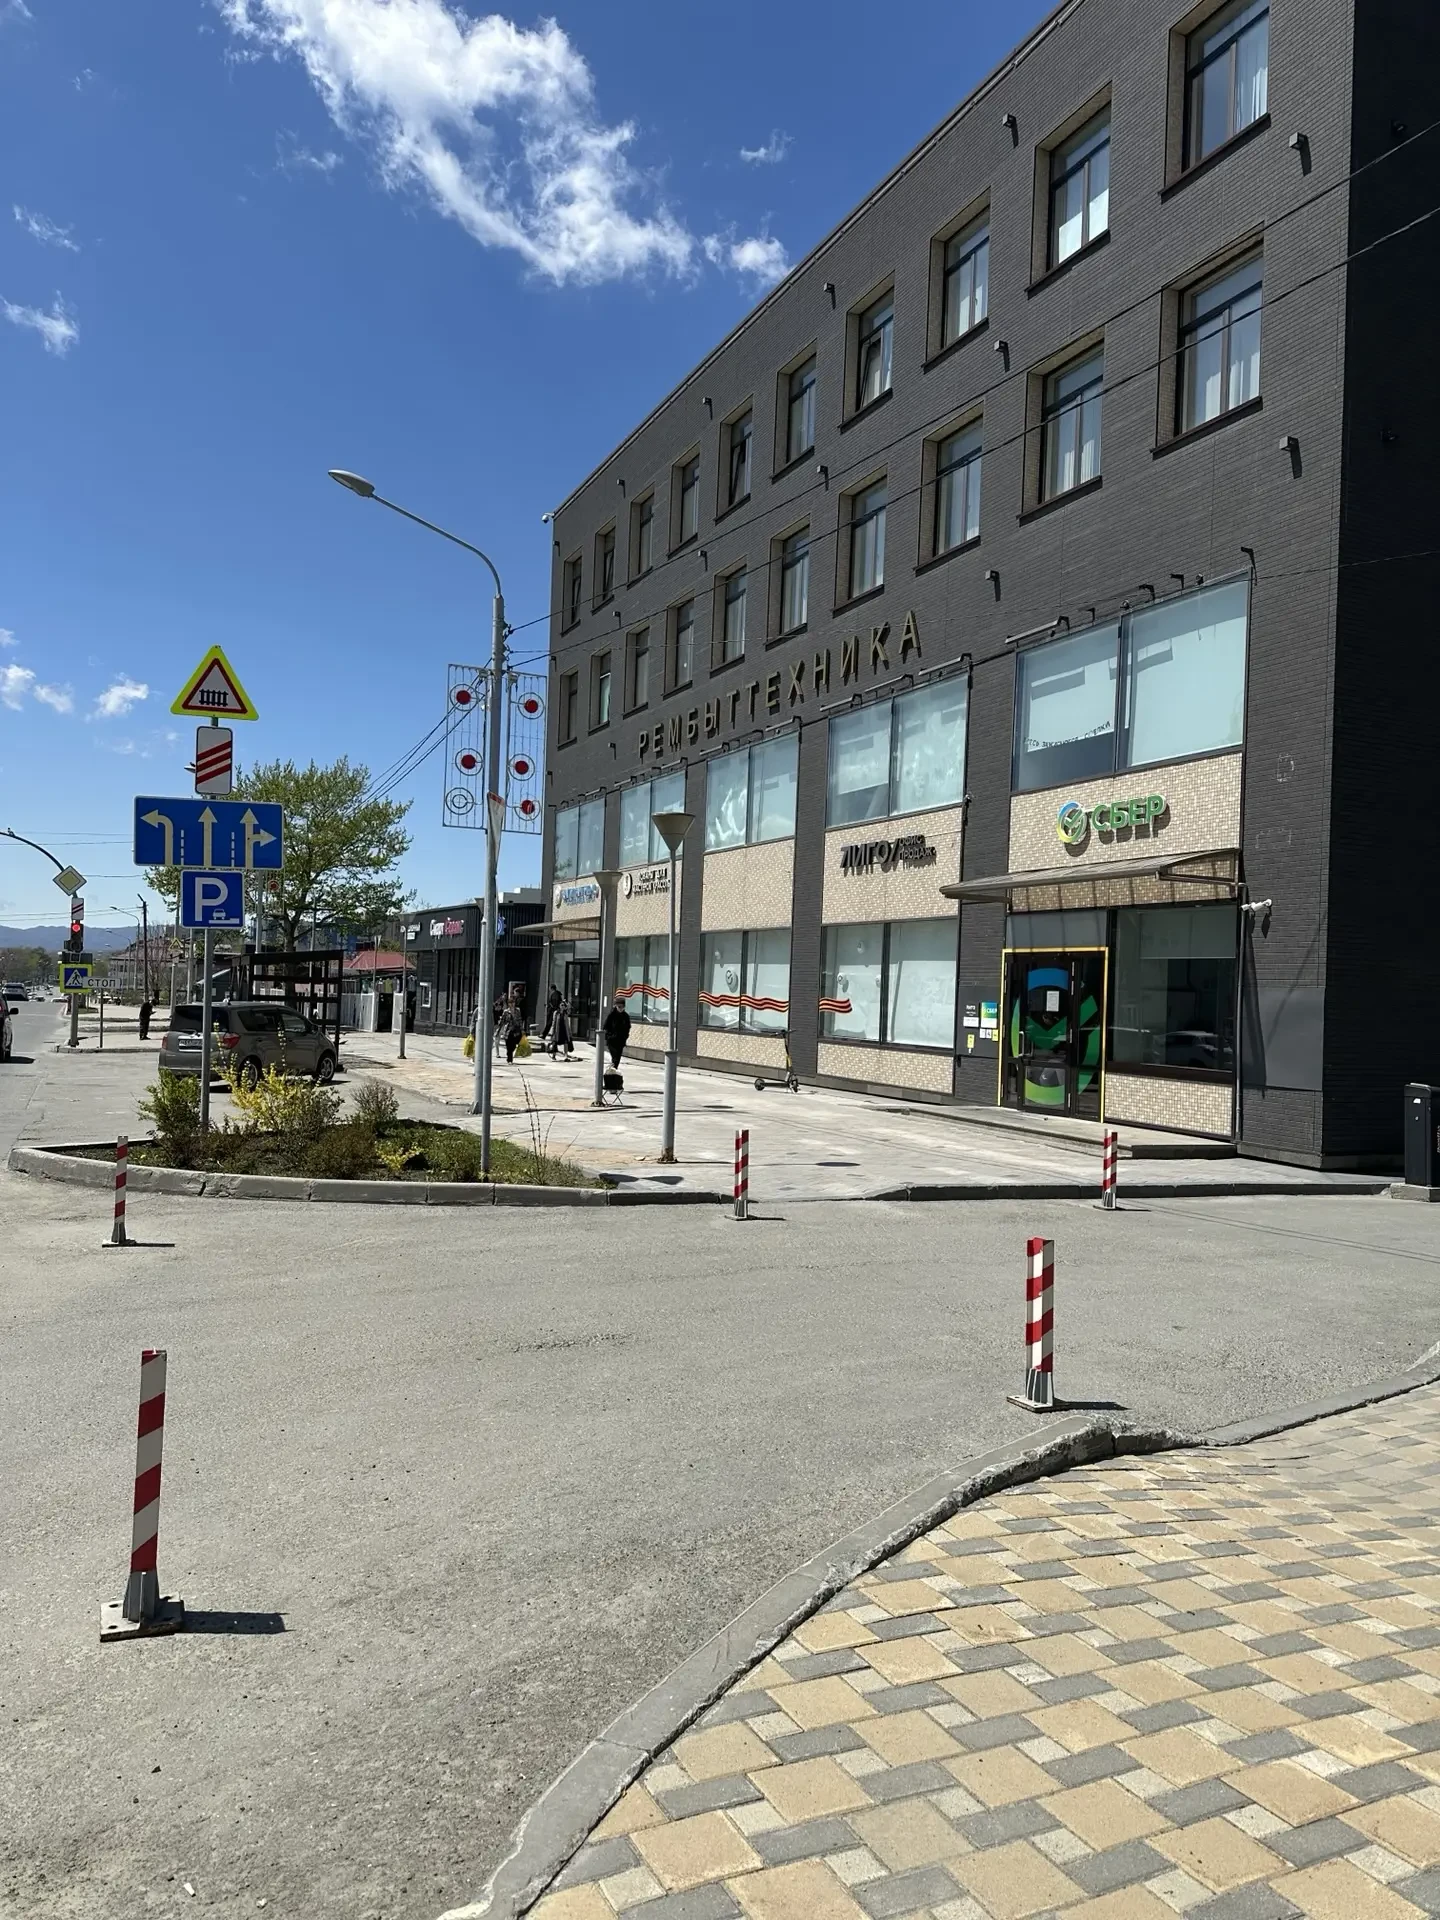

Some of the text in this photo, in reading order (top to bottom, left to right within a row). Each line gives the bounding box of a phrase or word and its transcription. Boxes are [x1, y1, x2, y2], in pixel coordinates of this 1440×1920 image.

[639, 610, 920, 758] РЕМБЫТТЕХНИКА
[1091, 793, 1167, 832] СБЕР
[899, 834, 922, 846] ОФИС
[195, 876, 229, 922] P
[87, 978, 116, 988] СТОП
